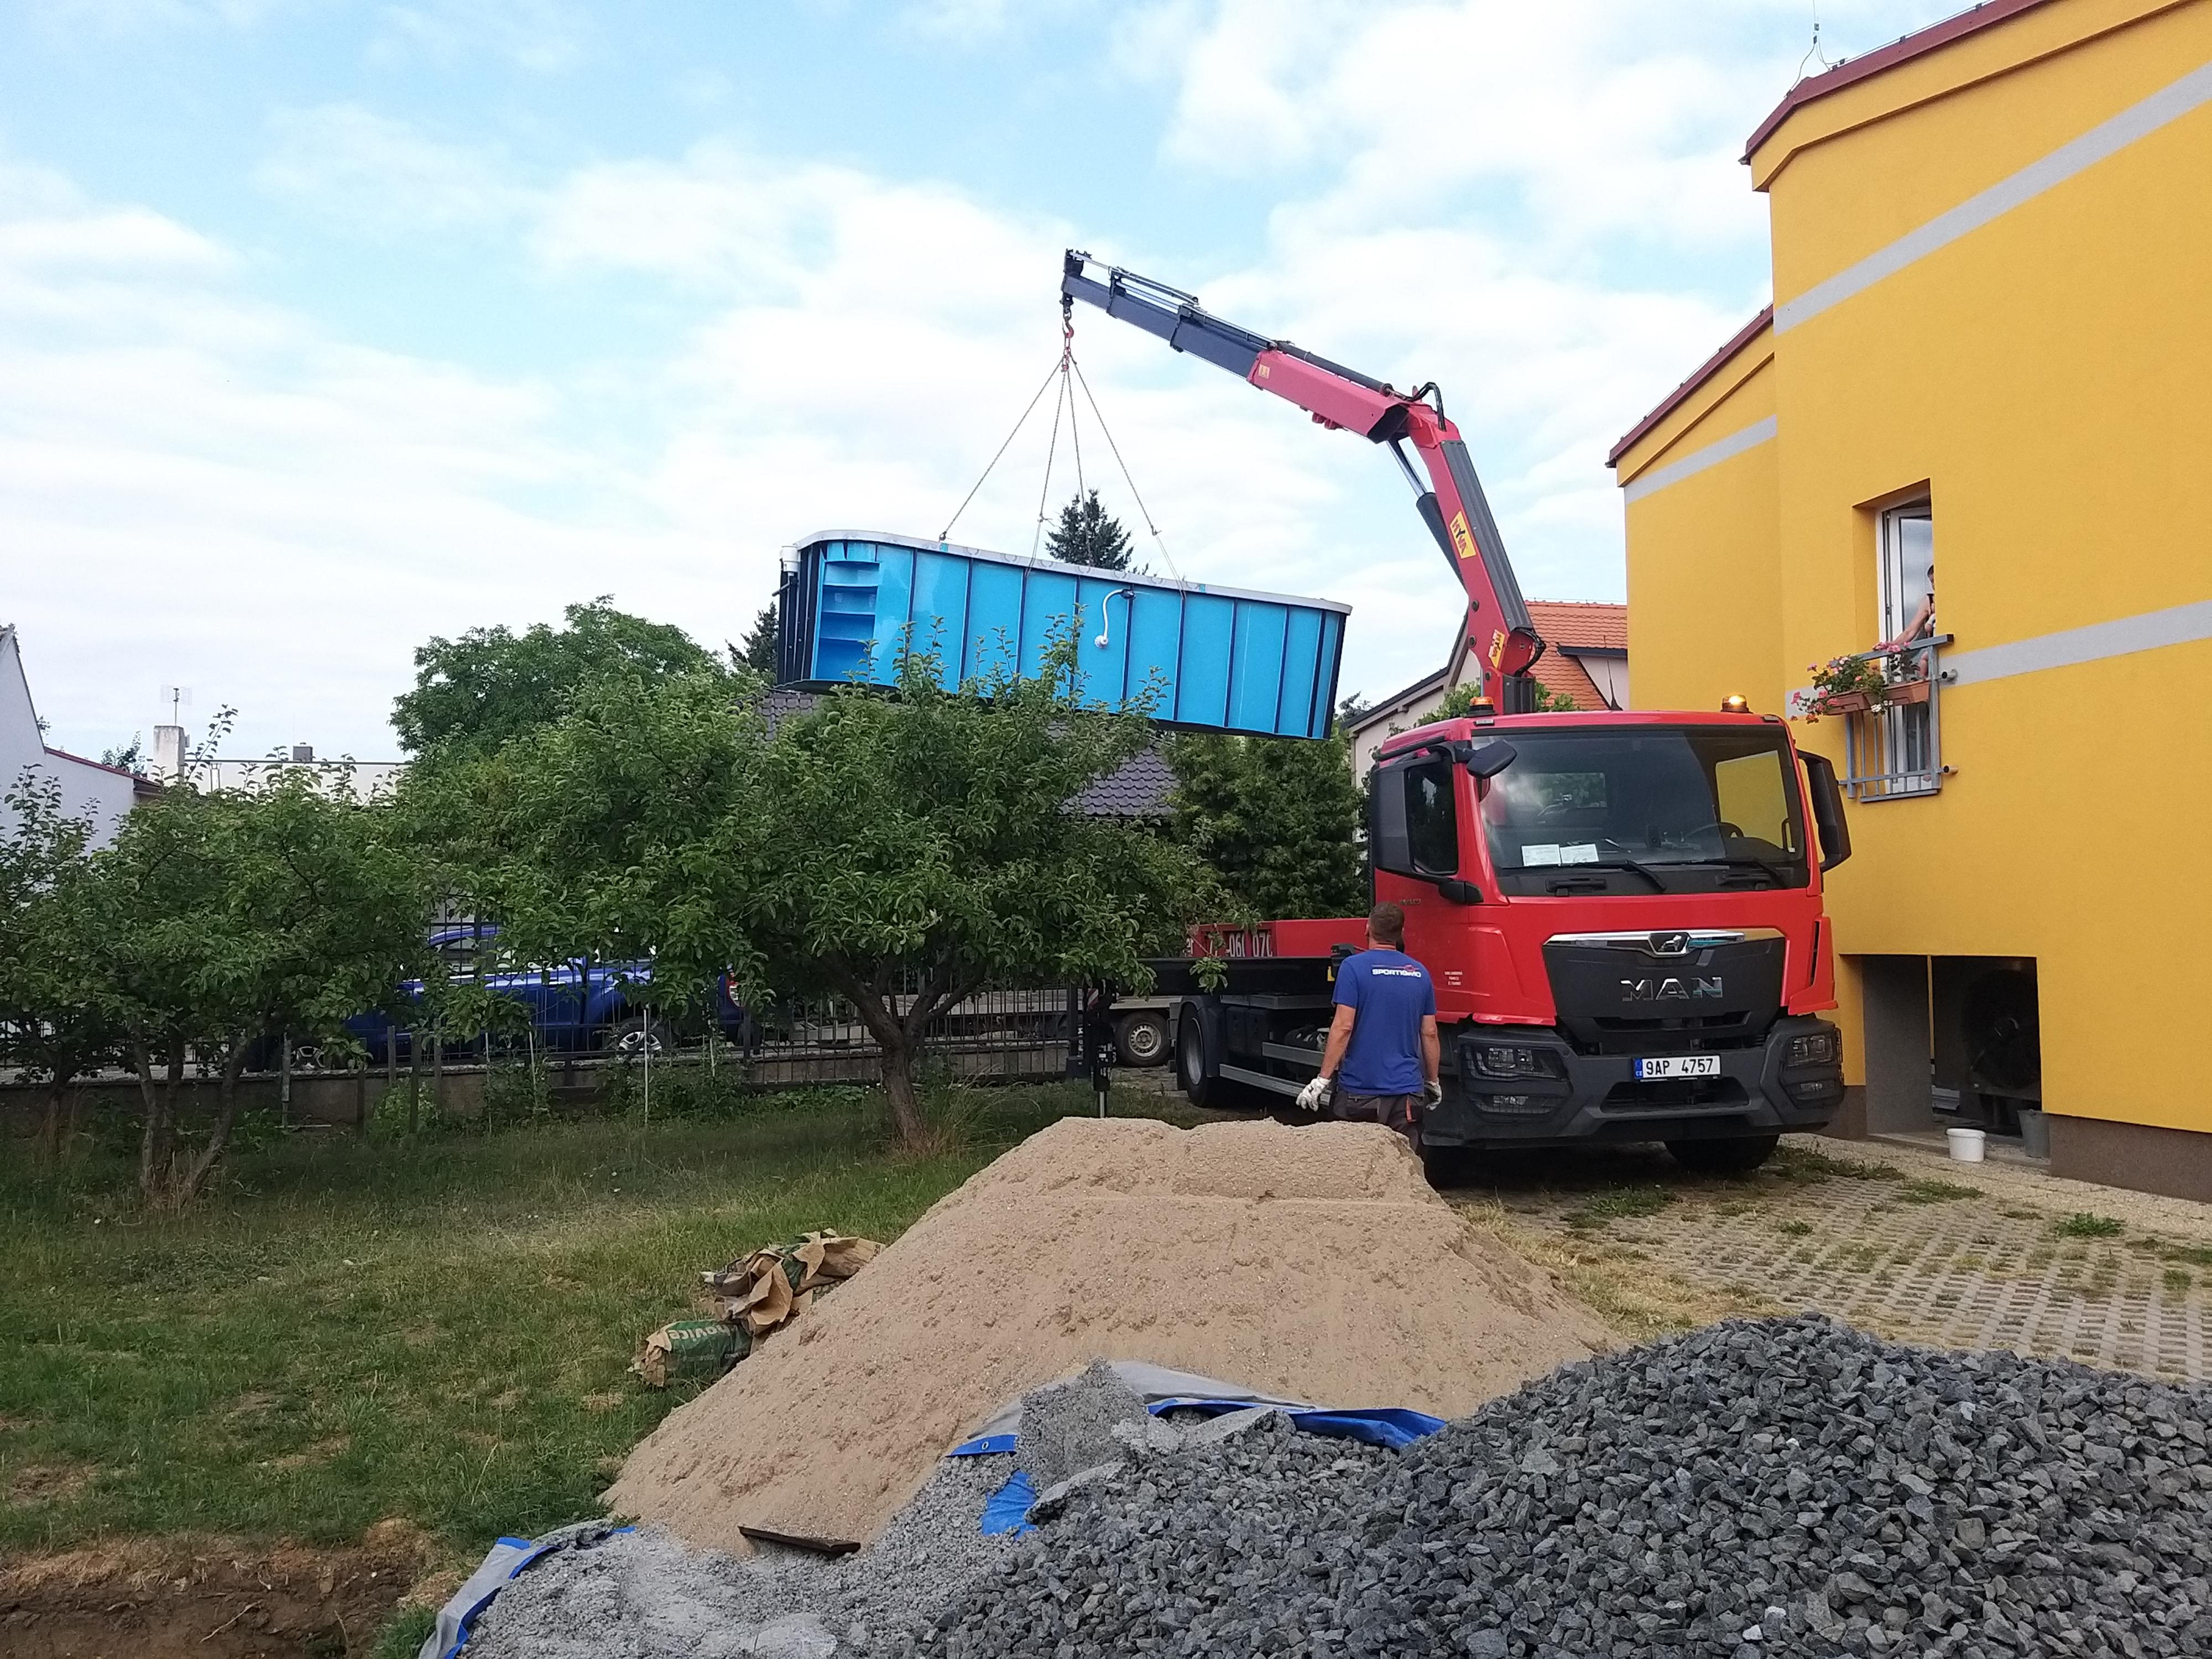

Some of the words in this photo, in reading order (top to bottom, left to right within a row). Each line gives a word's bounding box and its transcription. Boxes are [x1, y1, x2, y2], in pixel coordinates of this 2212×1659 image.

[1452, 519, 1468, 555] HYVA
[1620, 977, 1723, 1002] MAN
[1646, 1060, 1670, 1076] 9AP
[1682, 1058, 1713, 1074] 4757
